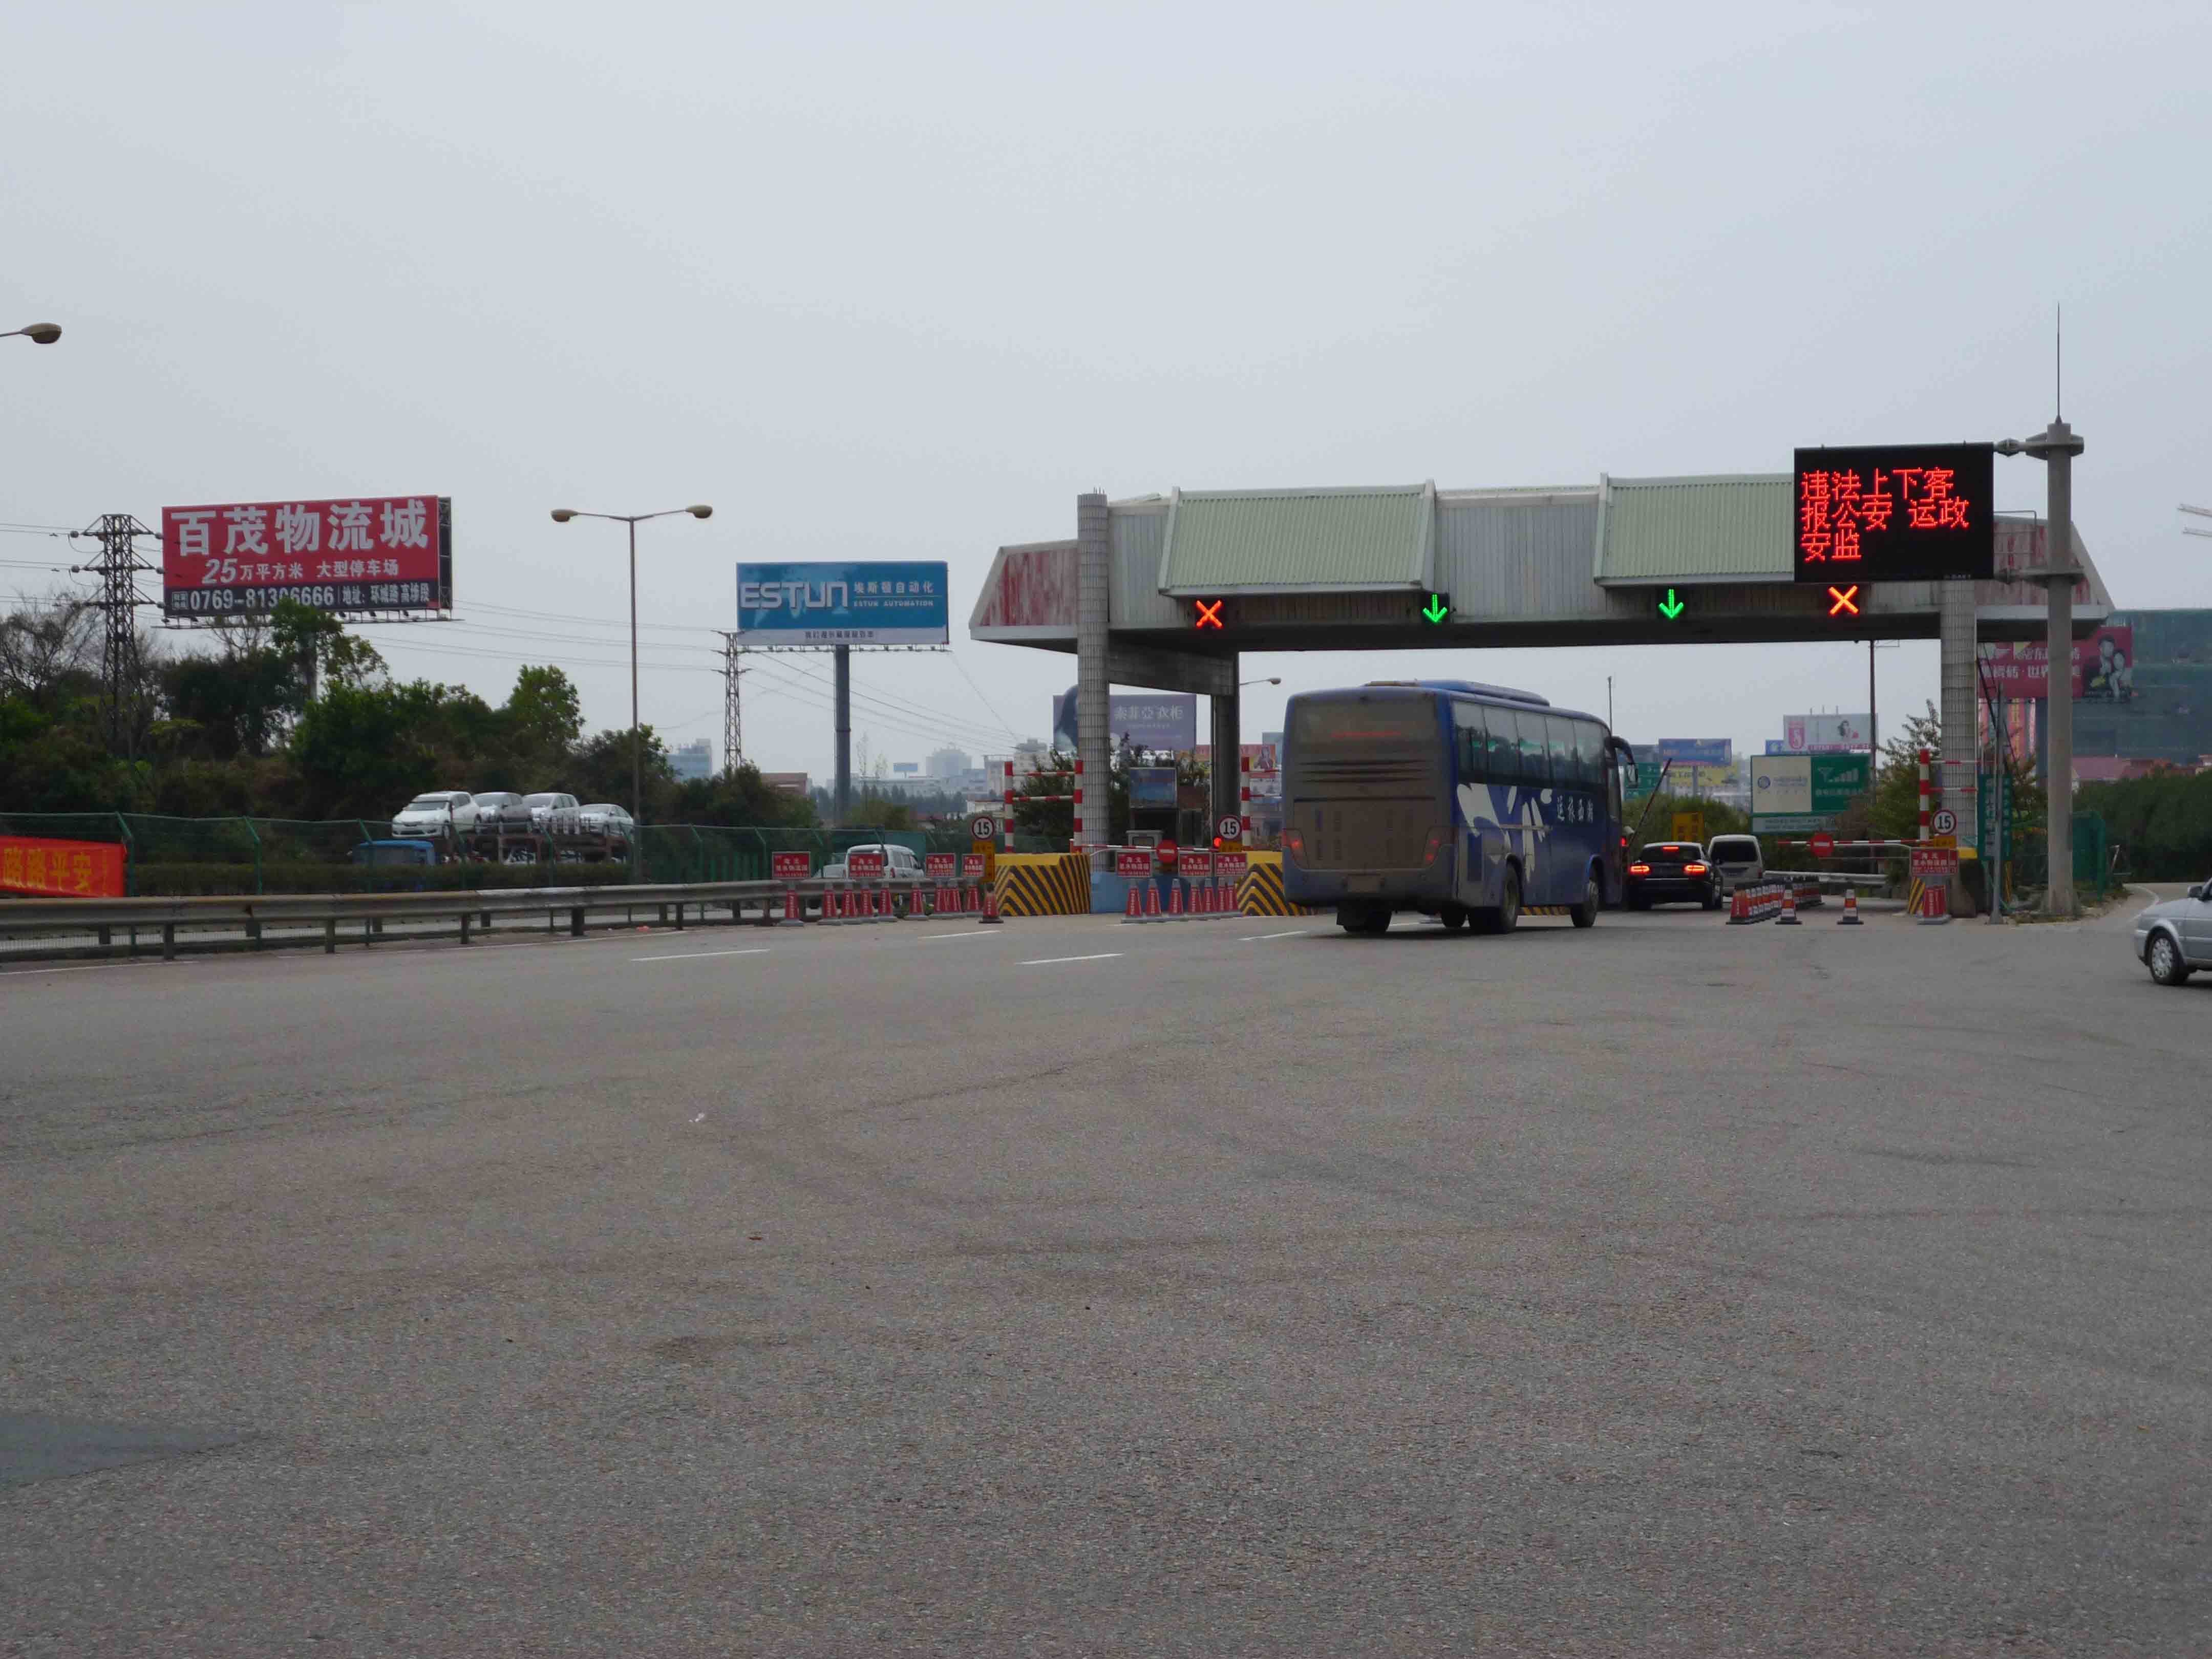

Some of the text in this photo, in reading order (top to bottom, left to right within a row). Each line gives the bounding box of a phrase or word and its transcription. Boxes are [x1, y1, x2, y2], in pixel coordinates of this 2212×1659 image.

[1801, 466, 1954, 500] 违法上下客
[1801, 496, 1970, 531] 报公安 运政
[171, 499, 429, 557] 百茂物流城
[1801, 528, 1862, 563] 安监
[201, 558, 399, 584] 25万平方米 大型停车场
[740, 581, 848, 608] ESTUN
[854, 581, 933, 594] 埃斯顿自动化
[977, 822, 990, 835] 15
[1223, 821, 1237, 835] 15
[1938, 815, 1951, 829] 15
